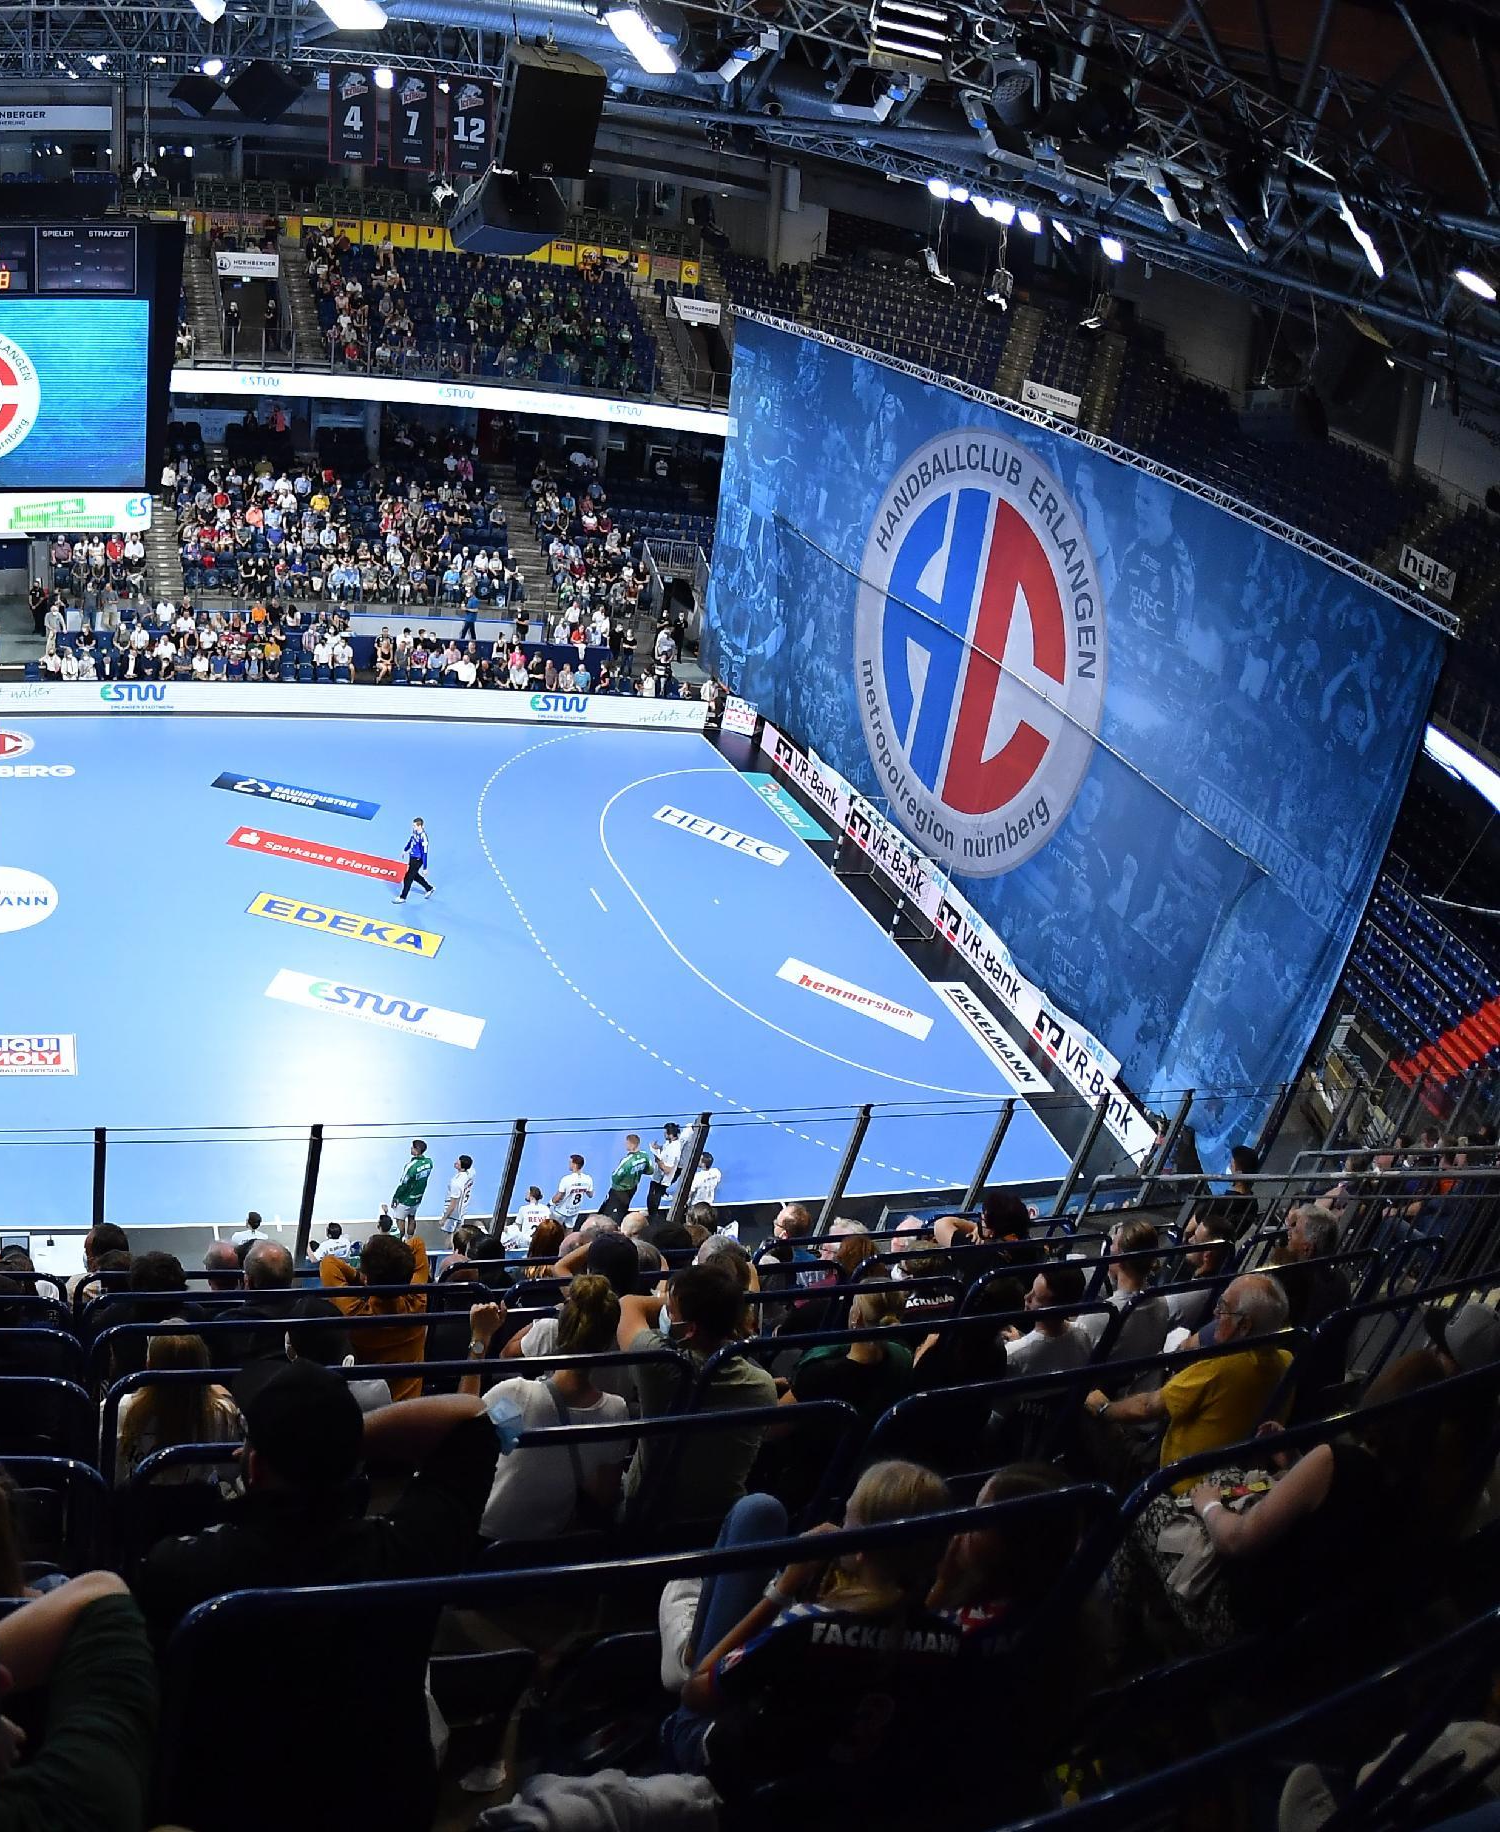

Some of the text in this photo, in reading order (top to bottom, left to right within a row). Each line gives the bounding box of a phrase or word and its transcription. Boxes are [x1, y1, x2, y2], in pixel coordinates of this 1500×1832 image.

[344, 105, 363, 131] 4
[406, 111, 419, 136] 7
[453, 116, 485, 144] 12
[42, 230, 130, 238] SPIELER STRAFZEIT
[875, 443, 1097, 680] HANDBALLCLUB ERLANGEN
[795, 751, 838, 812] VR-Bank
[862, 658, 1051, 858] metropolregion nürnberg
[270, 791, 316, 806] BAYERN
[274, 785, 359, 810] BAUINDUSTRIE
[263, 840, 398, 878] Sparkasse Erlangen
[661, 808, 783, 863] HEITEC
[262, 898, 424, 951] EDEKA
[961, 921, 1024, 1004] VR-Bank
[797, 972, 914, 1020] hemmersbach
[949, 987, 1036, 1084] FACKELMANN
[1065, 1035, 1133, 1136] VR-Bnk
[573, 1193, 582, 1206] 8
